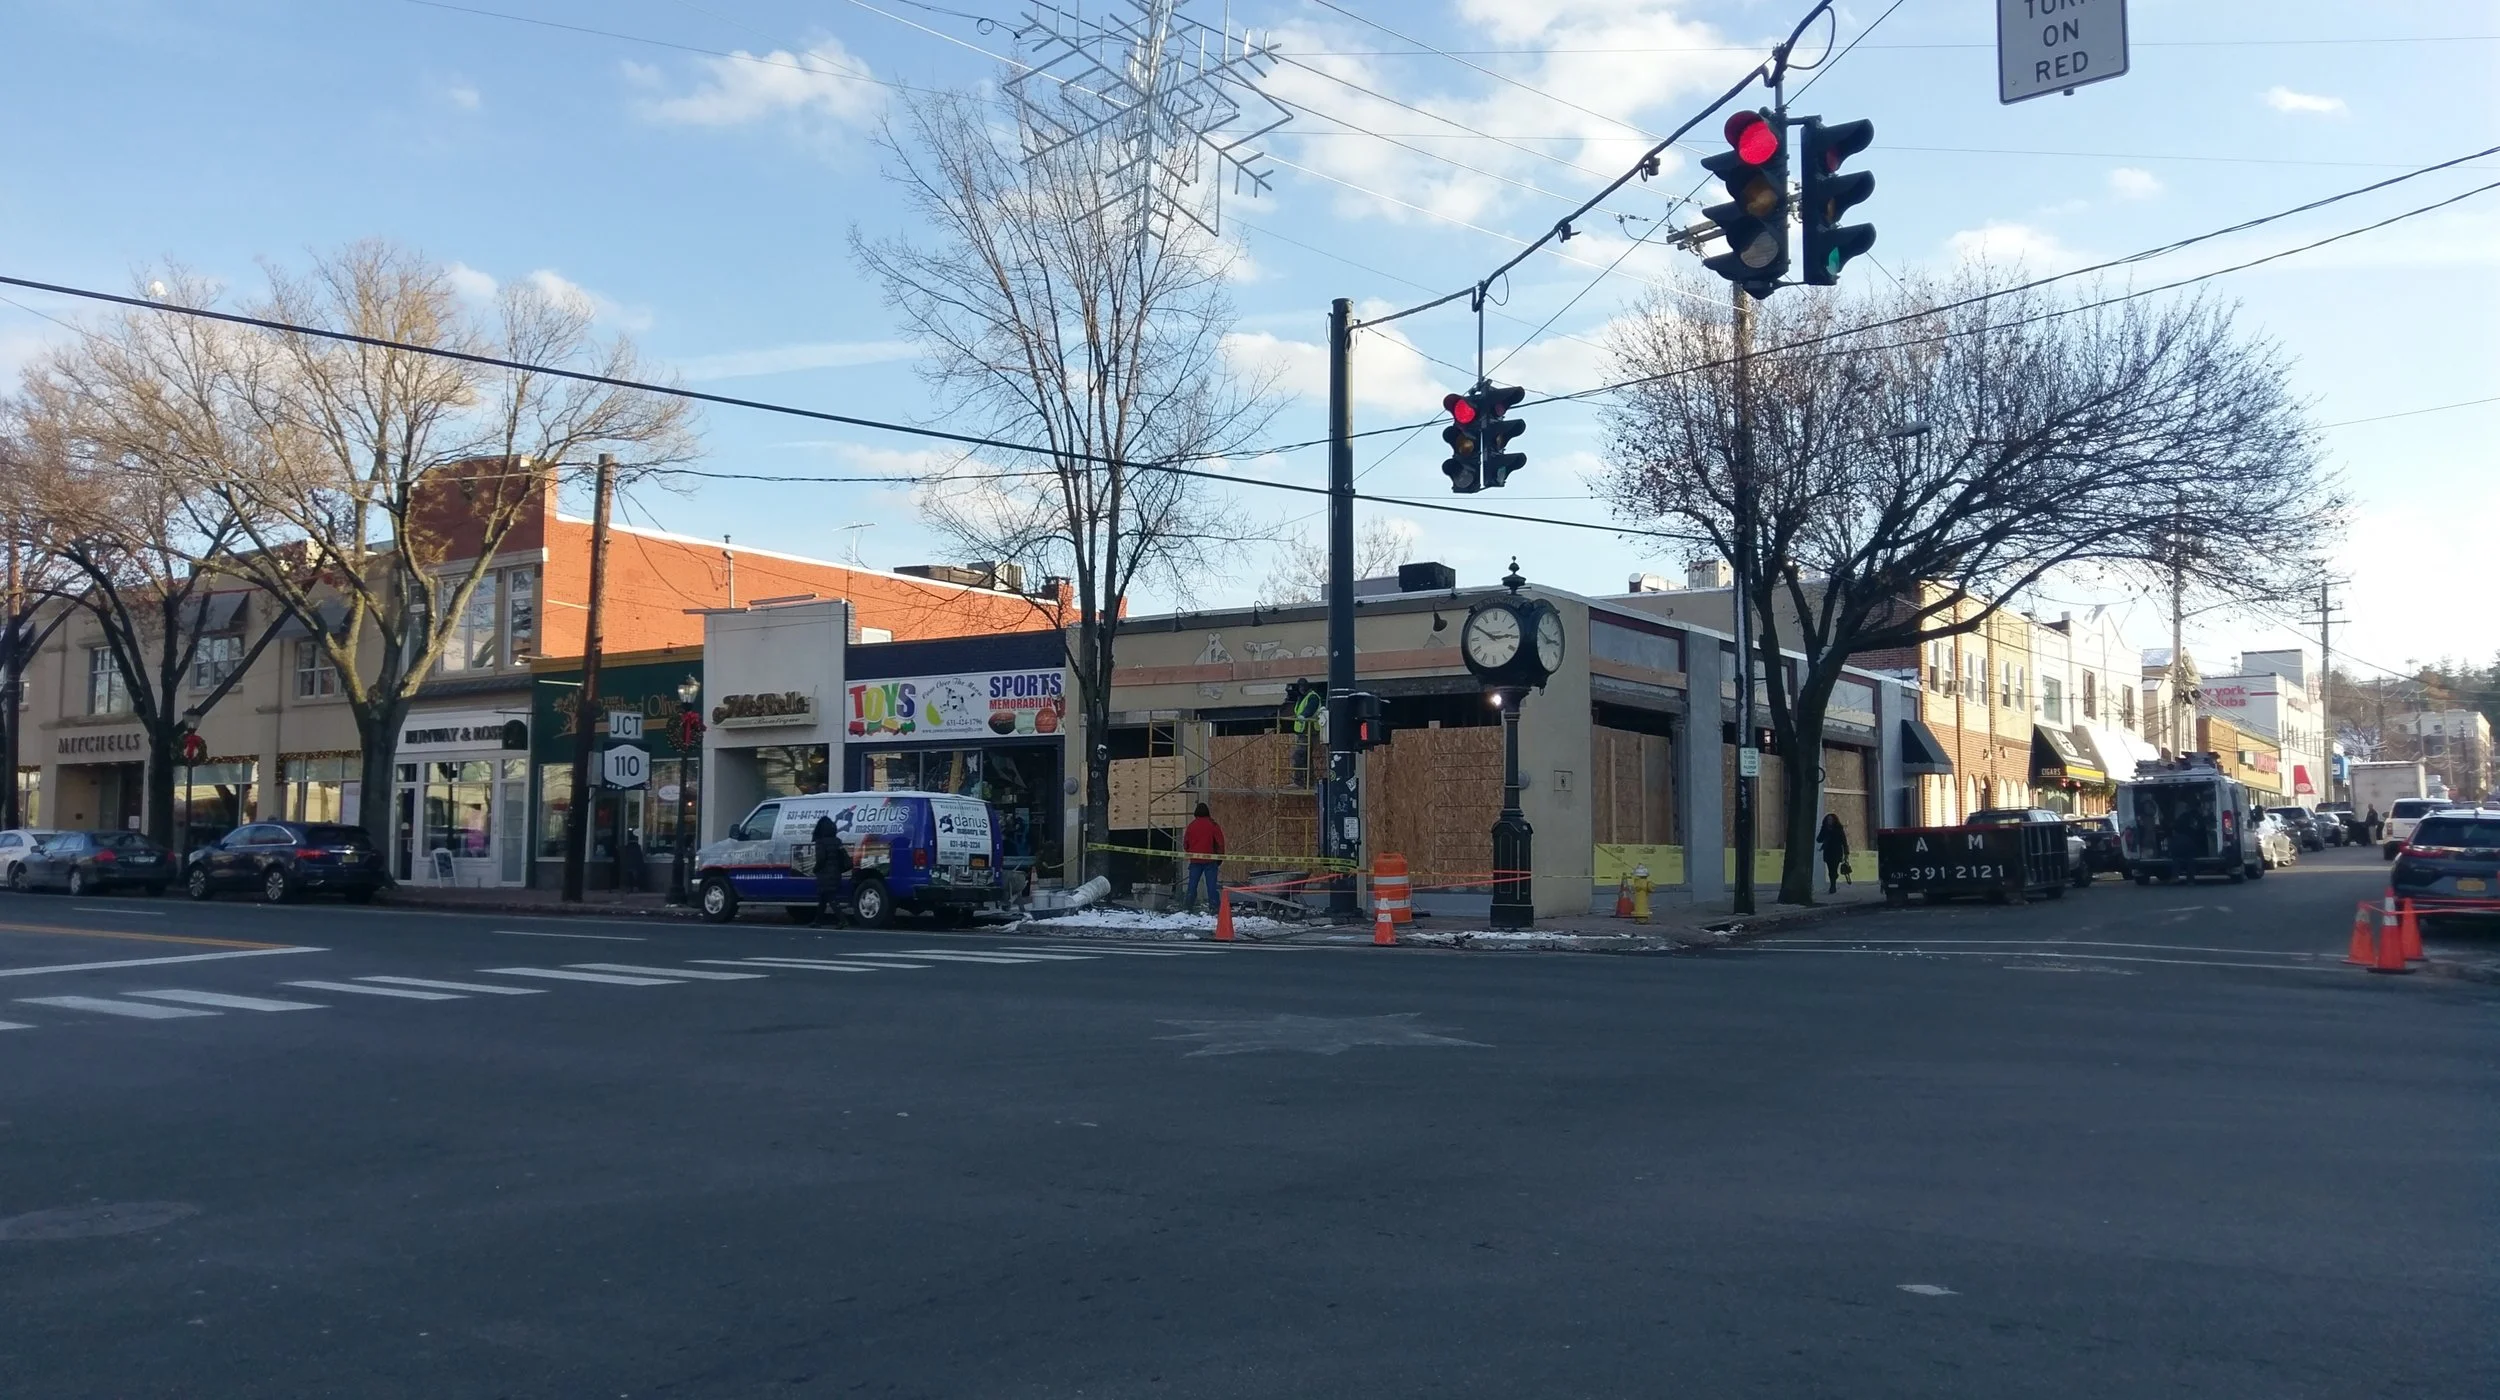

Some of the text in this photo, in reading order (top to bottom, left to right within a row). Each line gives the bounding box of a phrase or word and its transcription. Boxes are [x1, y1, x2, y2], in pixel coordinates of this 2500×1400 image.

[2024, 0, 2096, 19] TU
[2043, 18, 2079, 47] ON
[2035, 50, 2089, 83] RED
[989, 673, 1062, 698] SPORTS
[2215, 685, 2246, 698] york
[648, 693, 682, 717] Olive
[849, 683, 916, 722] TOYS
[989, 697, 1053, 710] MEMORABILIA
[461, 727, 472, 741] &
[612, 715, 641, 736] JCT
[58, 733, 141, 754] MITCHELLS
[614, 755, 640, 776] 110
[2041, 767, 2061, 776] CIGARS
[856, 803, 910, 823] darius
[954, 813, 988, 829] darius
[1915, 834, 1983, 852] A M
